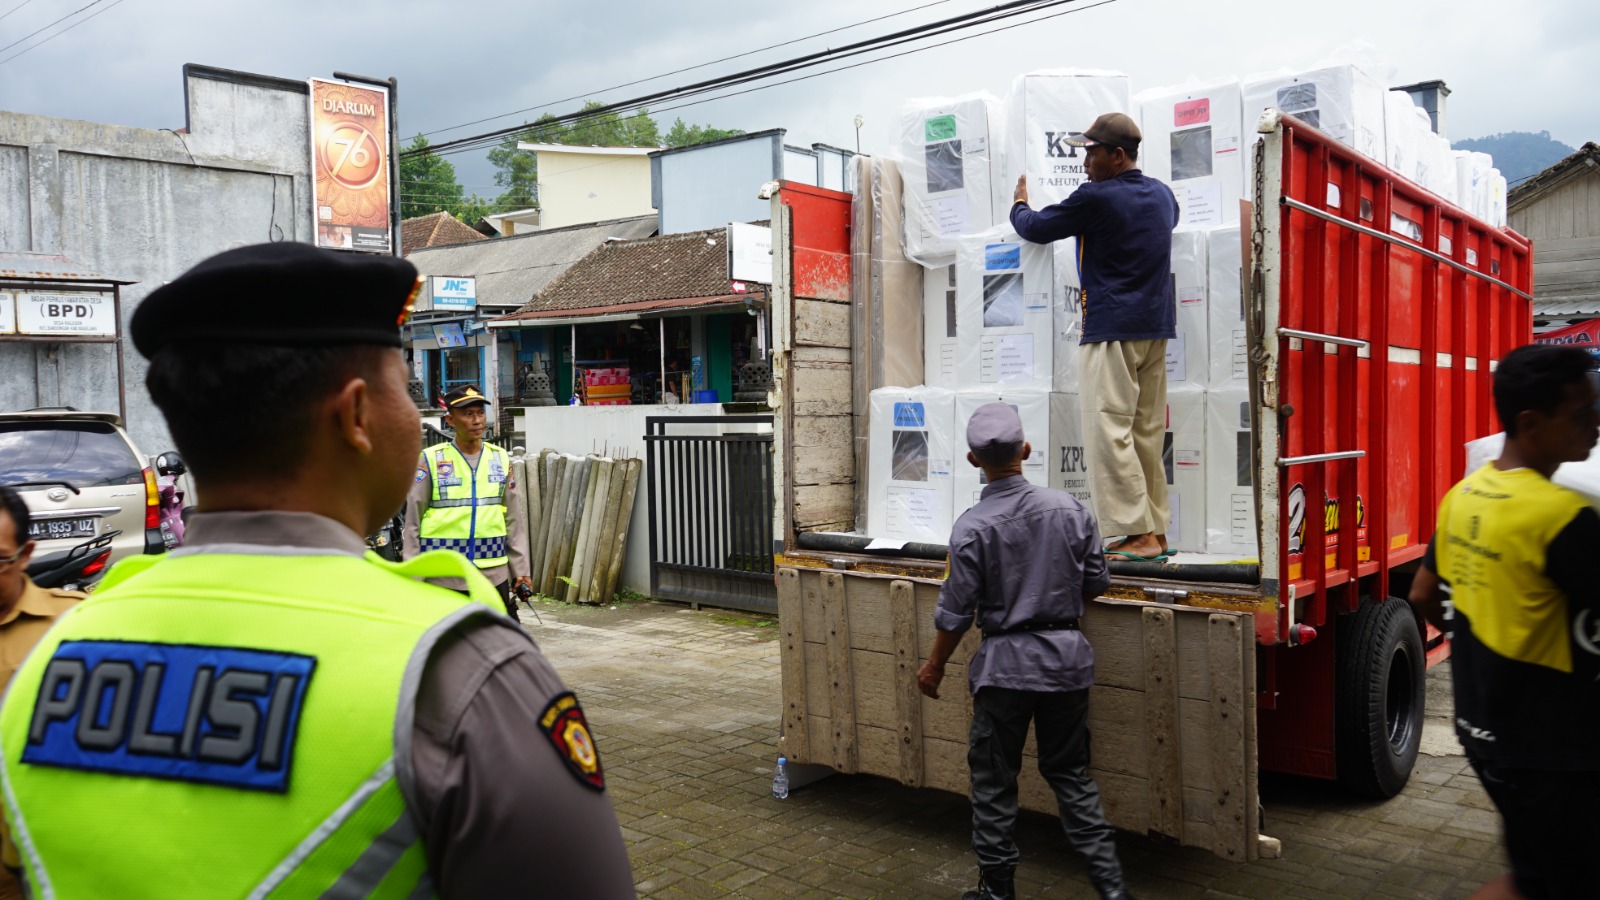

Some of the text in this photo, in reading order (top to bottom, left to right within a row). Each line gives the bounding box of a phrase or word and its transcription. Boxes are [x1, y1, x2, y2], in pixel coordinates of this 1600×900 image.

[323, 98, 376, 116] DJARUM
[331, 129, 370, 177] 76
[1053, 165, 1087, 174] PEMI
[1039, 177, 1079, 187] TAHUN
[442, 279, 468, 292] JNE
[1064, 285, 1081, 314] KP
[48, 521, 72, 533] 1935
[79, 519, 93, 531] UZ
[27, 658, 301, 771] POLISI
